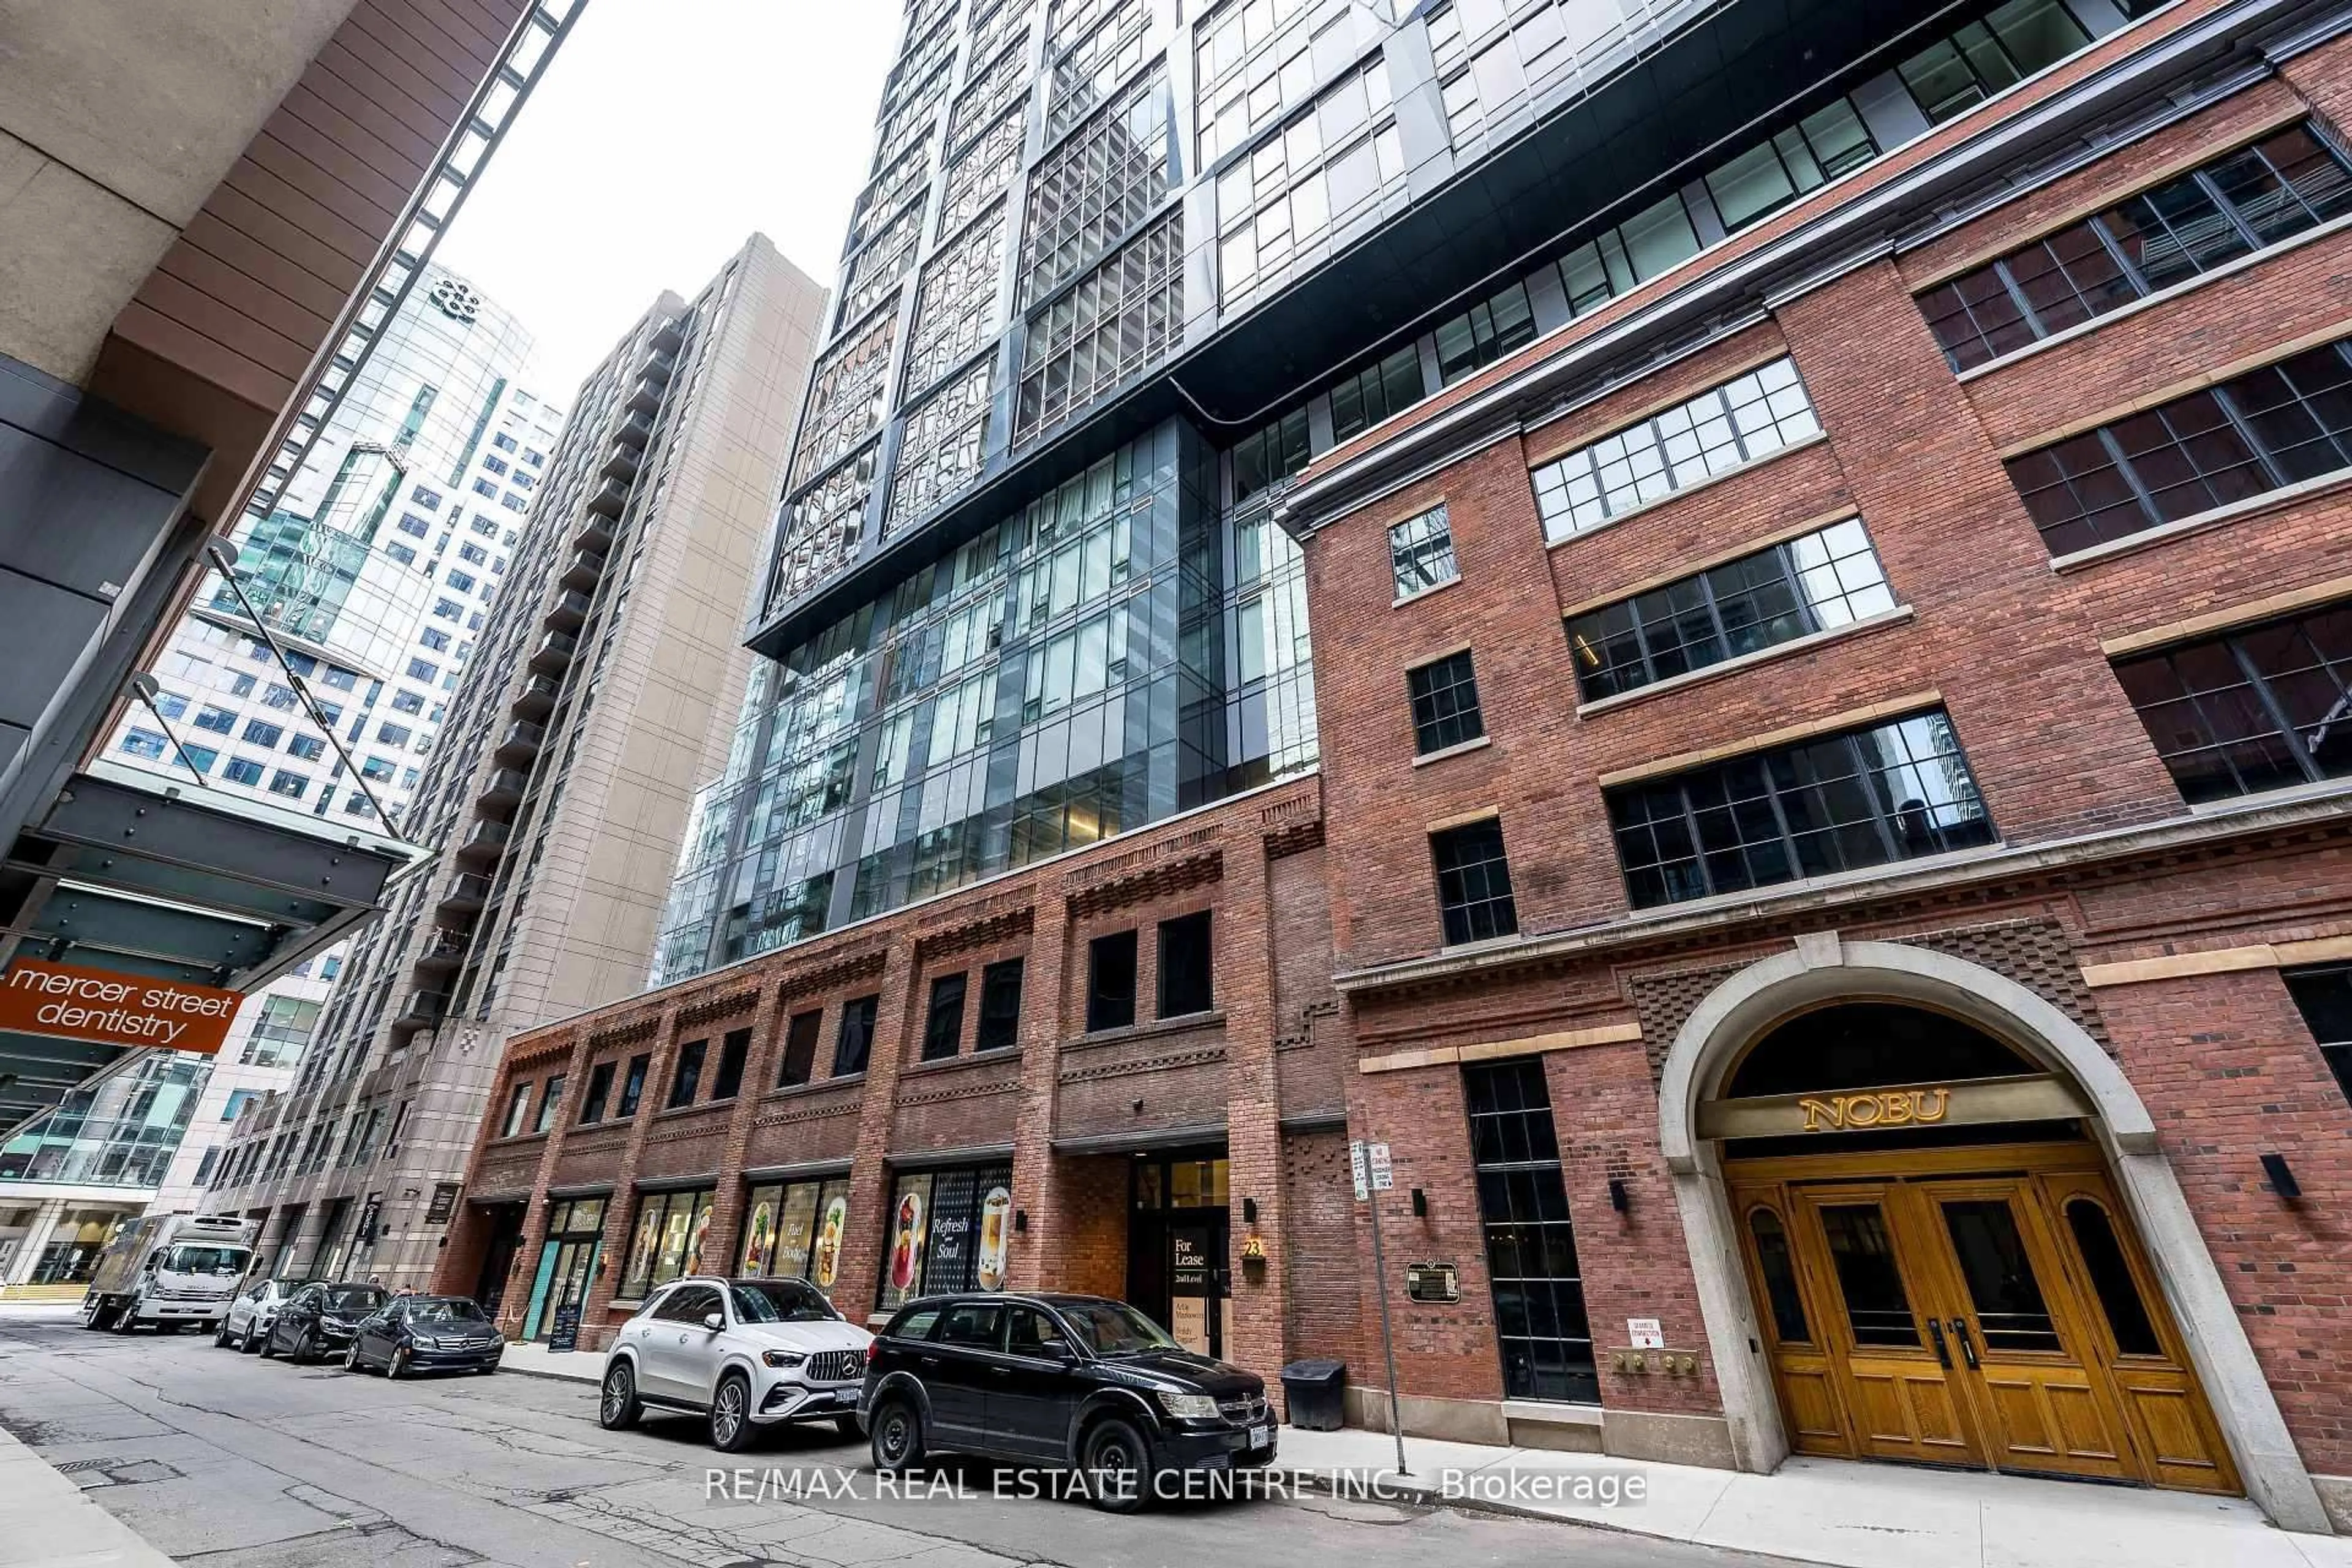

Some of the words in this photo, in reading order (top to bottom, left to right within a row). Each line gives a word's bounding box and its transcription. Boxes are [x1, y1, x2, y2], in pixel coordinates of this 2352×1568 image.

[10, 969, 138, 1003] mercer
[141, 989, 233, 1018] street
[37, 1000, 187, 1044] dentistry
[1800, 1088, 1951, 1131] NOBU
[932, 1216, 970, 1237] Refresh
[937, 1242, 959, 1259] Soul
[1175, 1239, 1192, 1252] For
[1245, 1241, 1260, 1256] 23
[1175, 1253, 1204, 1266] Lease
